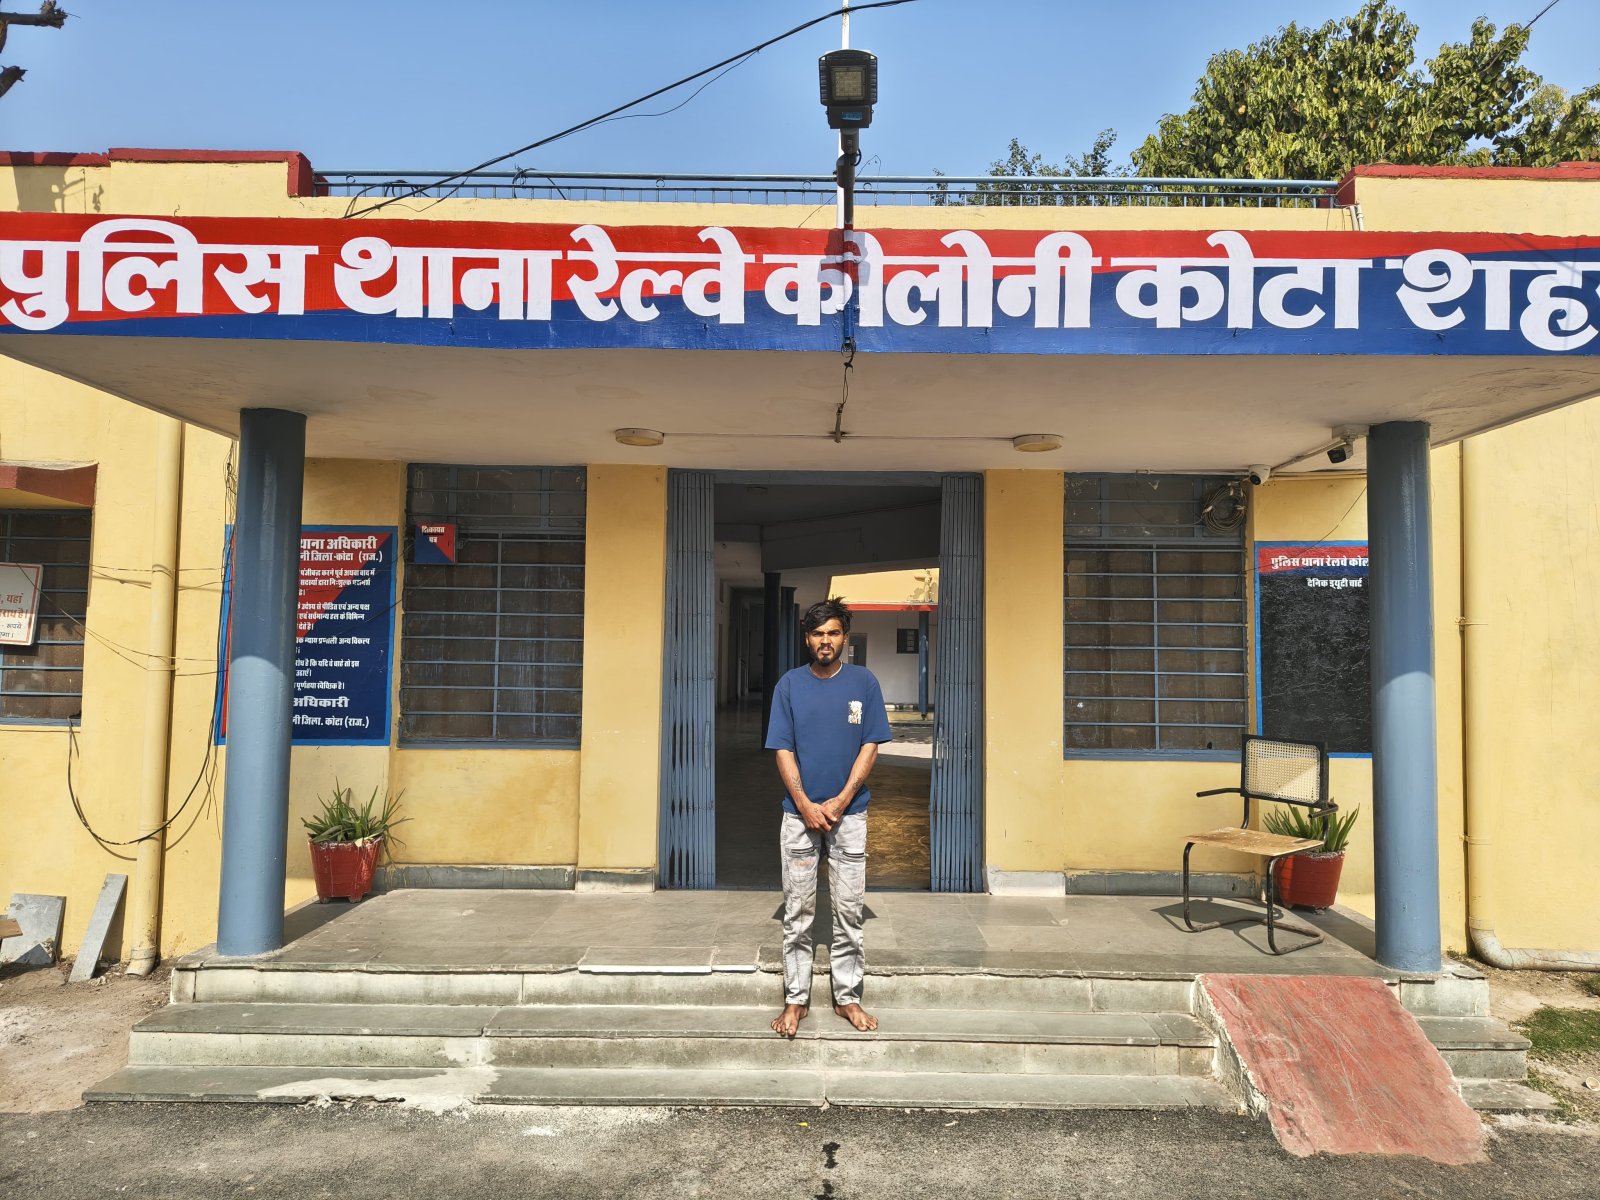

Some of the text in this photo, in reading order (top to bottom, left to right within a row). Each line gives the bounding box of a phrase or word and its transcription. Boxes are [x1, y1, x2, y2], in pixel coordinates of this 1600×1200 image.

[0, 218, 319, 331] पुलिस
[334, 236, 562, 320] थाना
[566, 224, 755, 325] रेल्वे
[1110, 231, 1373, 329] कोटा
[1384, 248, 1600, 351] शह
[327, 536, 377, 549] अधिकारी
[311, 550, 333, 562] जिला
[358, 550, 383, 563] (राज.)
[1270, 555, 1300, 569] पुलिस
[1301, 557, 1325, 567] थाना
[1306, 577, 1363, 590] दैनिक ड्यूटी चार्ट
[293, 695, 350, 708] अधिकारी
[324, 715, 344, 726] कोटा
[345, 716, 369, 728] (राज.)
